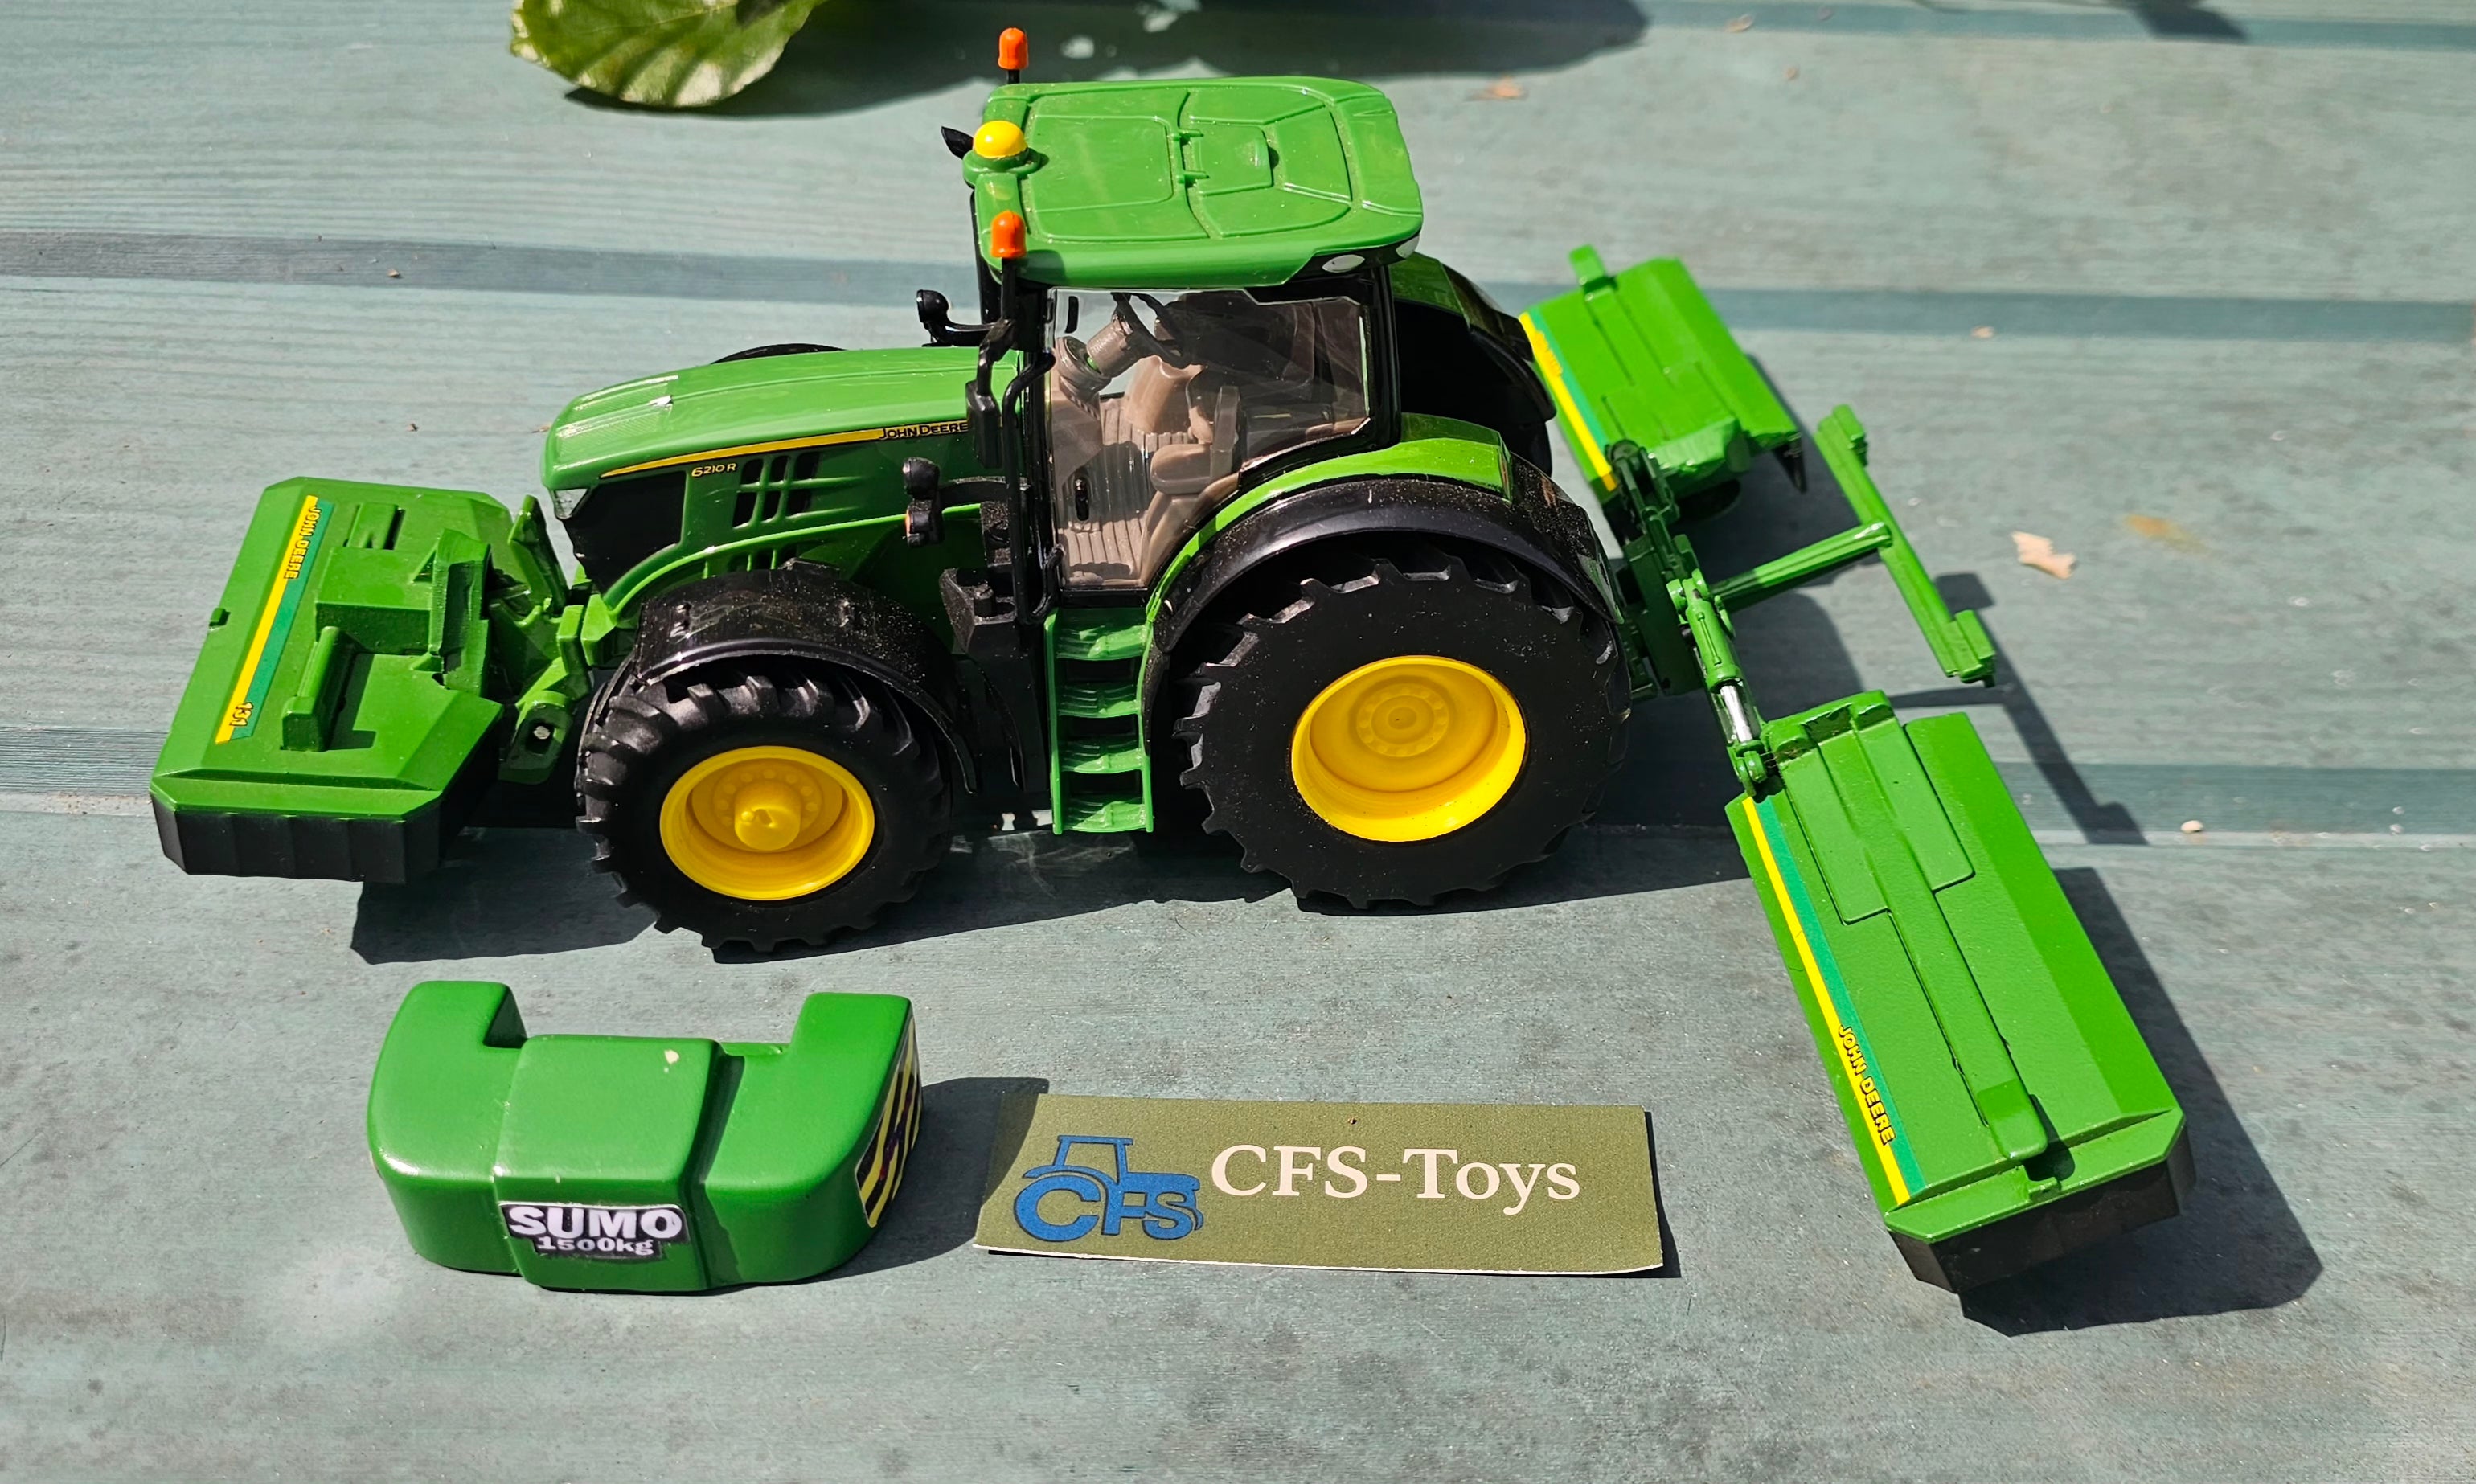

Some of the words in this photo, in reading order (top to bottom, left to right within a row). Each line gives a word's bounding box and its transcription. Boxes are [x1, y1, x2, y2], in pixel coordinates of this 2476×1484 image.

[879, 427, 918, 440] JOHN
[918, 421, 968, 435] DEERE
[299, 506, 322, 537] JOHN
[284, 539, 311, 580] DEERE
[1839, 1025, 1868, 1076] JOHN
[1860, 1076, 1896, 1146] DEERE
[1211, 1144, 1580, 1215] CFS-Toys
[508, 1206, 683, 1240] SUMO
[536, 1236, 654, 1256] 1500kg
